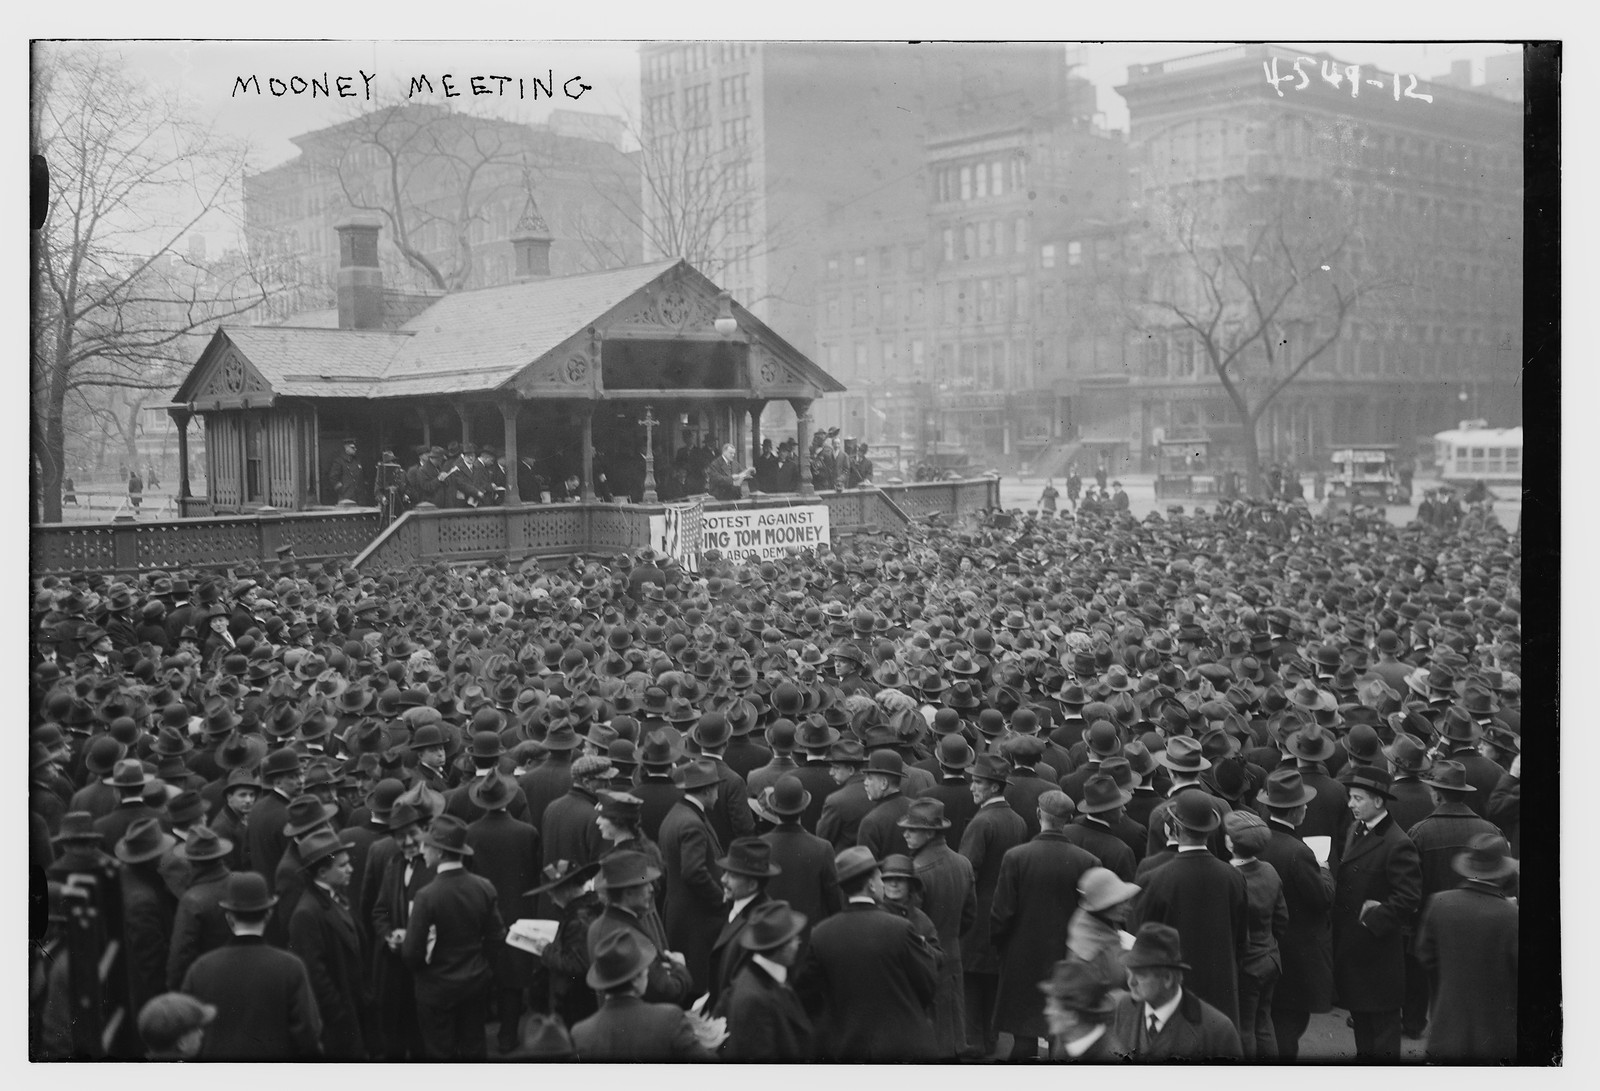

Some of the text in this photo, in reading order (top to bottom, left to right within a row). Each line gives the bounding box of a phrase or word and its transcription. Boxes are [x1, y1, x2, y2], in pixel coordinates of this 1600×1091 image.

[701, 511, 814, 530] ROTEST AGAINST
[734, 528, 762, 547] TOM
[765, 525, 824, 545] MOONEY
